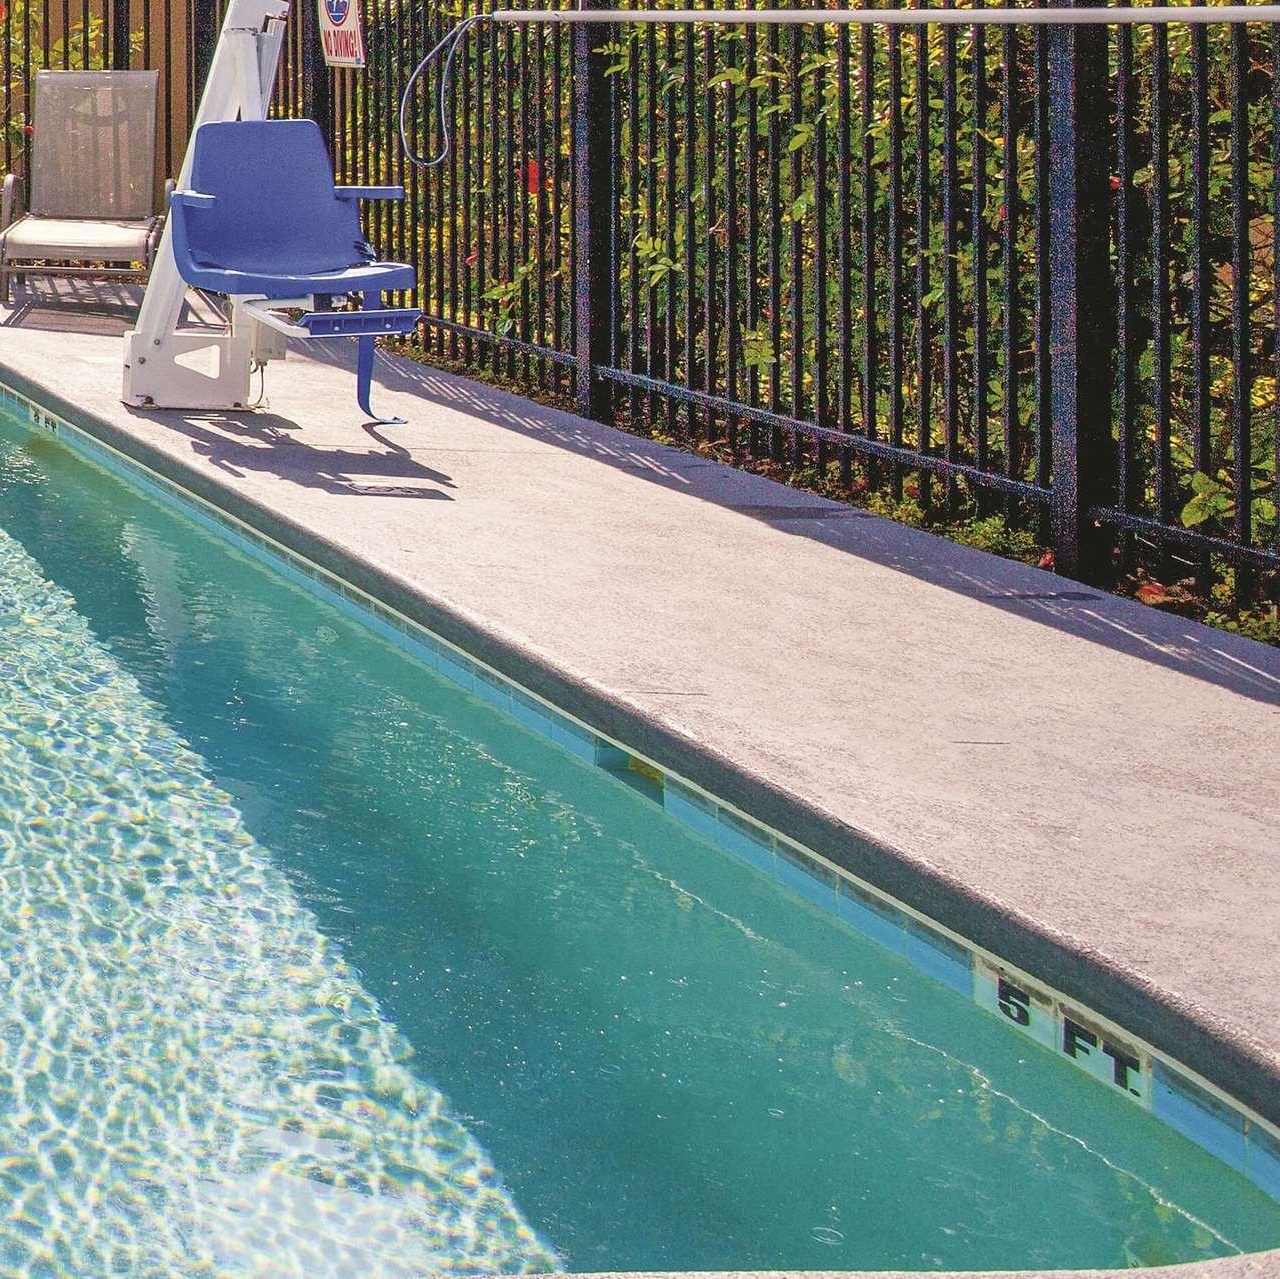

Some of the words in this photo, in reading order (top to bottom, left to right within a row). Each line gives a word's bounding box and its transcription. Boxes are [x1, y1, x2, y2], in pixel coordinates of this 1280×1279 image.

[323, 29, 333, 57] NO
[333, 29, 358, 59] DIVING!
[997, 976, 1030, 1027] 5
[1062, 1017, 1141, 1097] FT.
